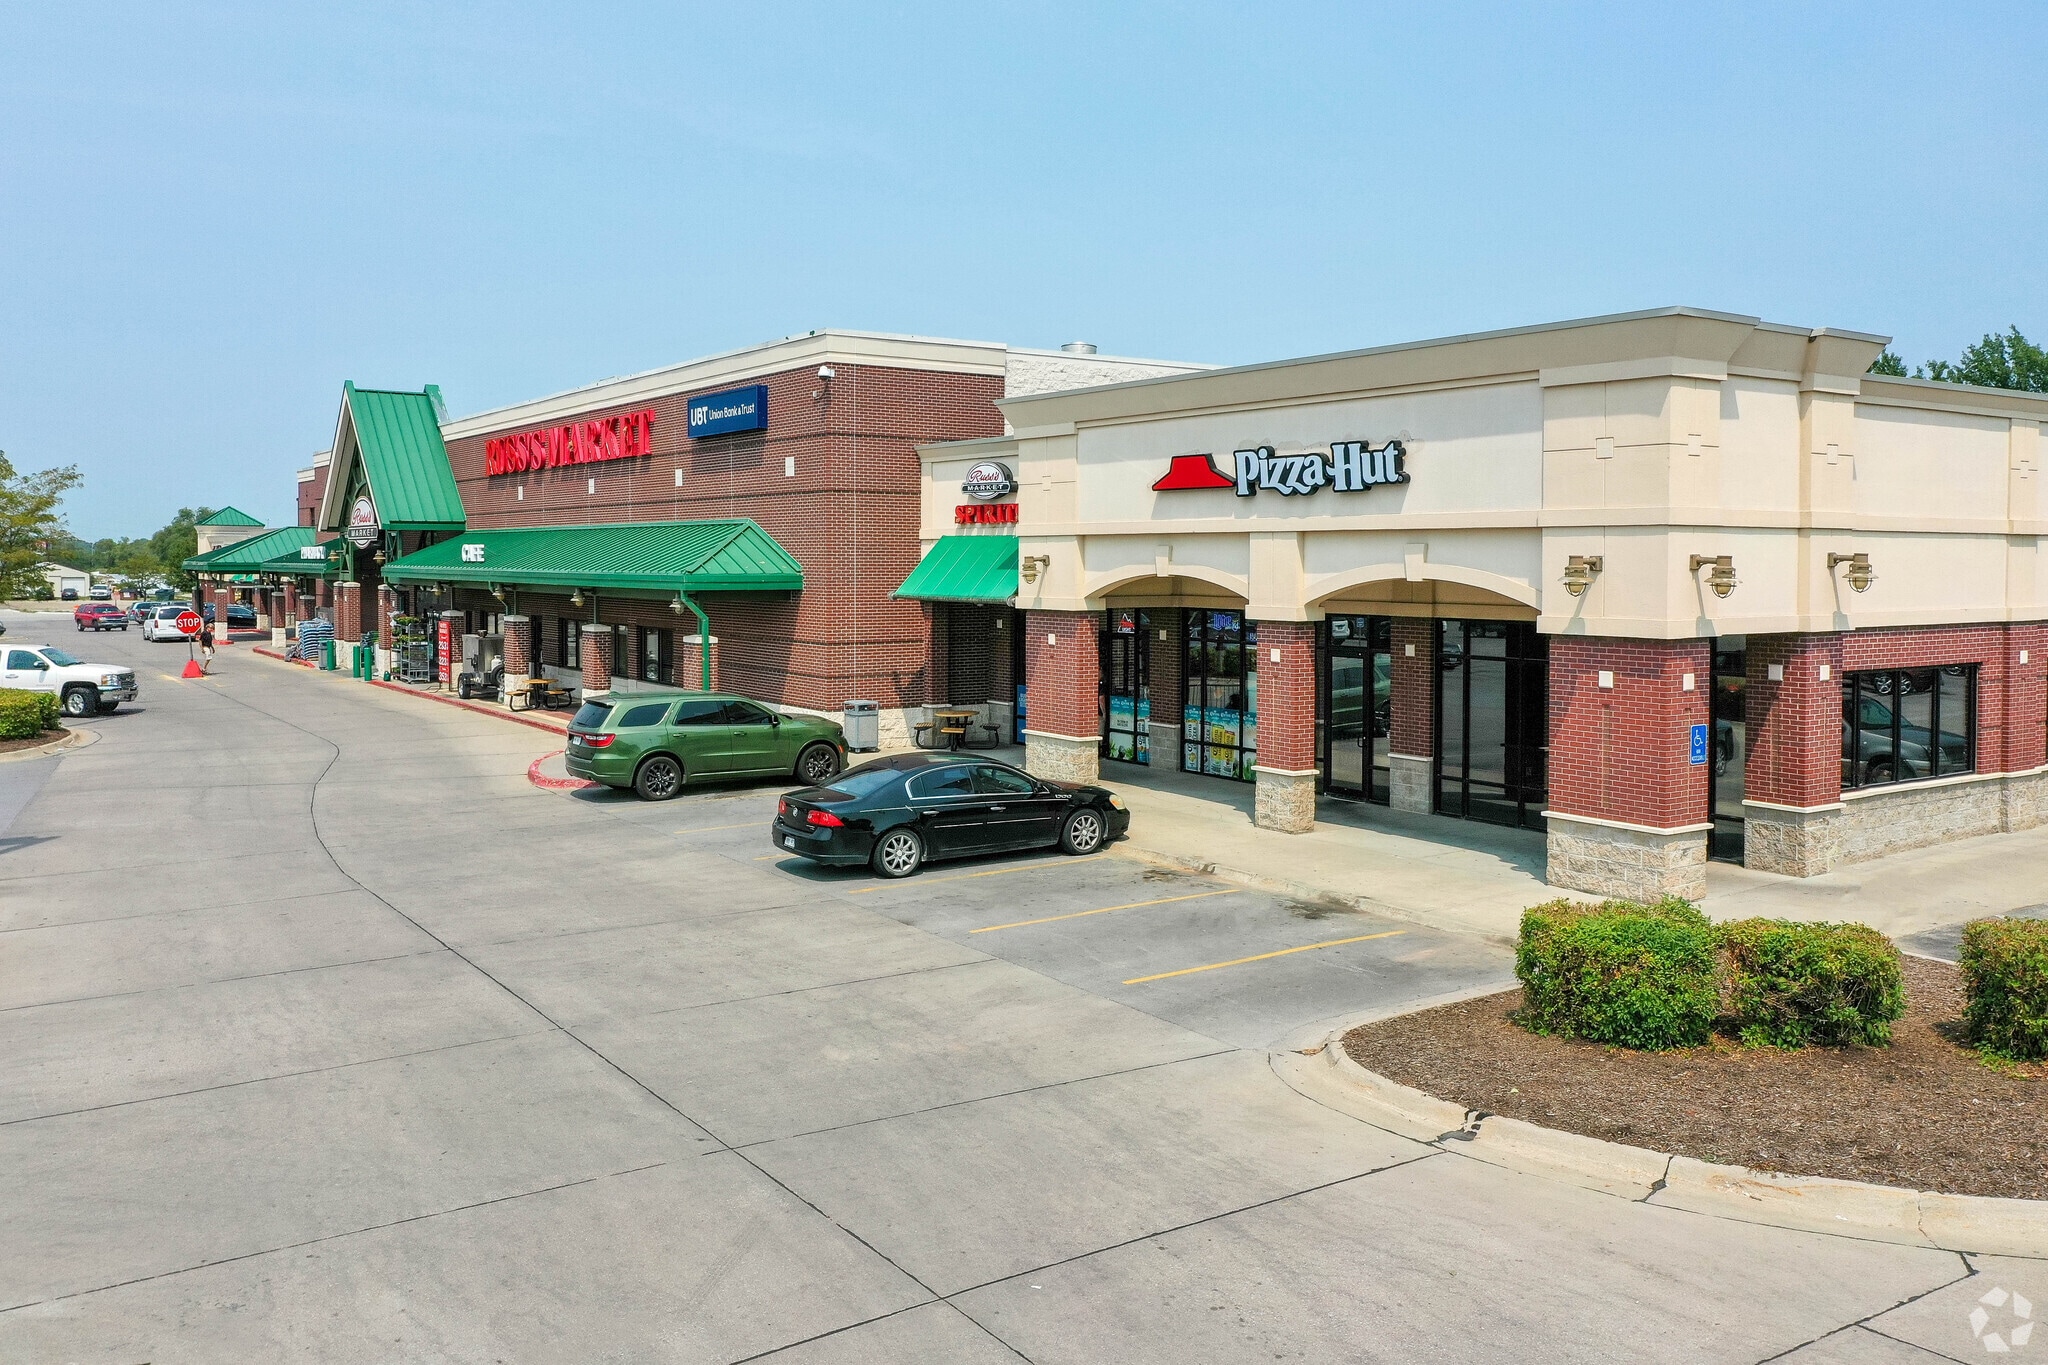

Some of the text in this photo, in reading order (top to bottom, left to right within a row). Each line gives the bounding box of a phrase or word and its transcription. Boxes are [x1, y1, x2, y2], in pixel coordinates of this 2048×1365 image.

[690, 406, 708, 427] UBT
[709, 408, 723, 420] Union
[723, 405, 738, 418] Bank
[741, 403, 755, 415] Trust
[548, 410, 655, 468] MARKET
[1234, 441, 1401, 497] Pizza Hut
[955, 504, 1018, 524] SPIRIT
[177, 617, 200, 628] STOP
